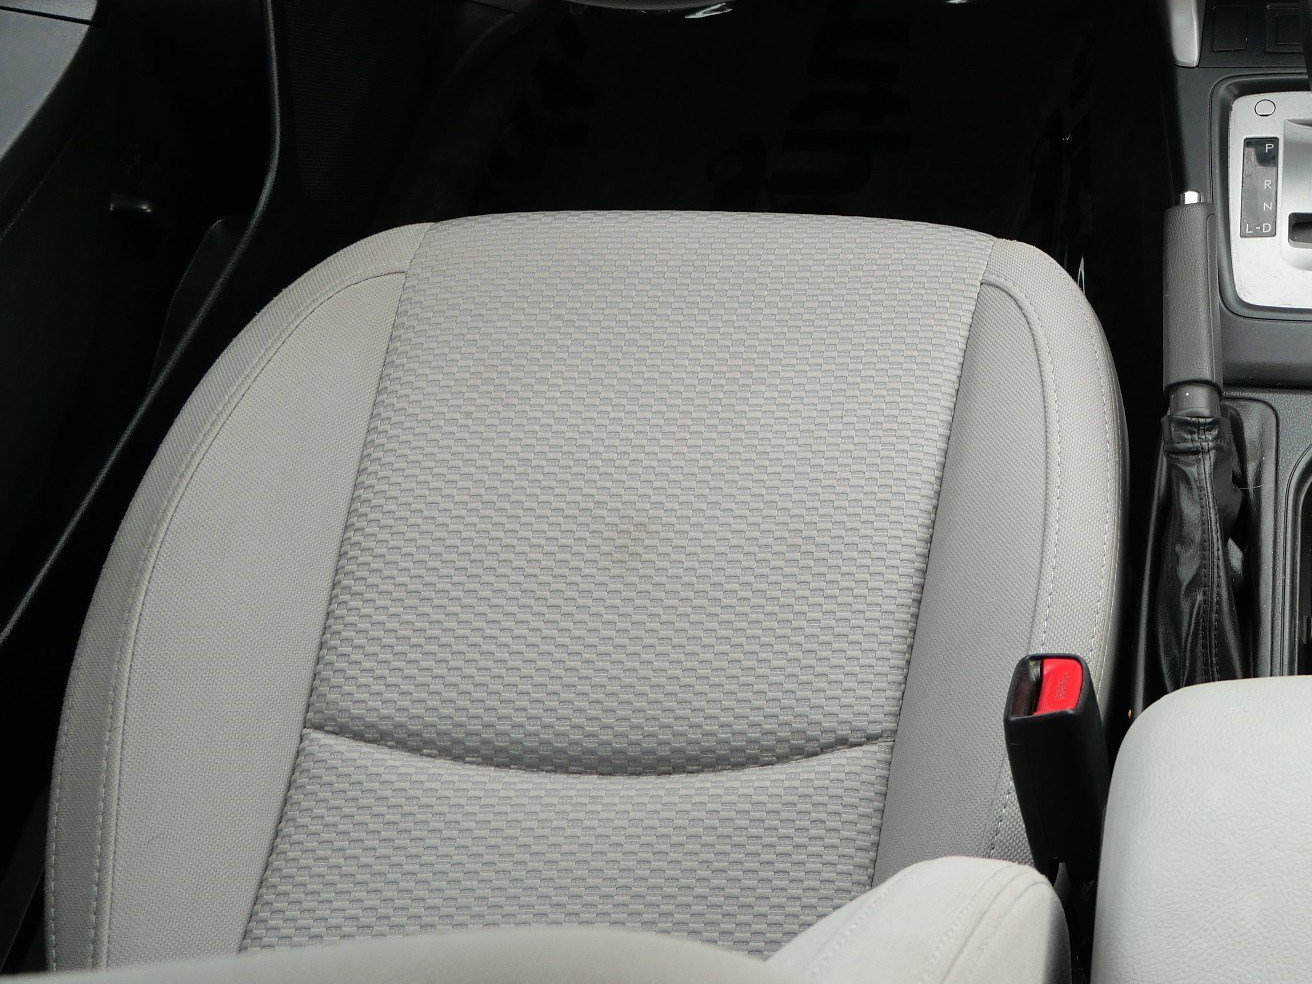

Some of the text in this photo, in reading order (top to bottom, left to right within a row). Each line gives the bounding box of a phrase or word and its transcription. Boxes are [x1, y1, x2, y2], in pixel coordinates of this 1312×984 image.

[1265, 143, 1274, 153] P
[1264, 179, 1273, 189] R
[1263, 201, 1273, 212] N
